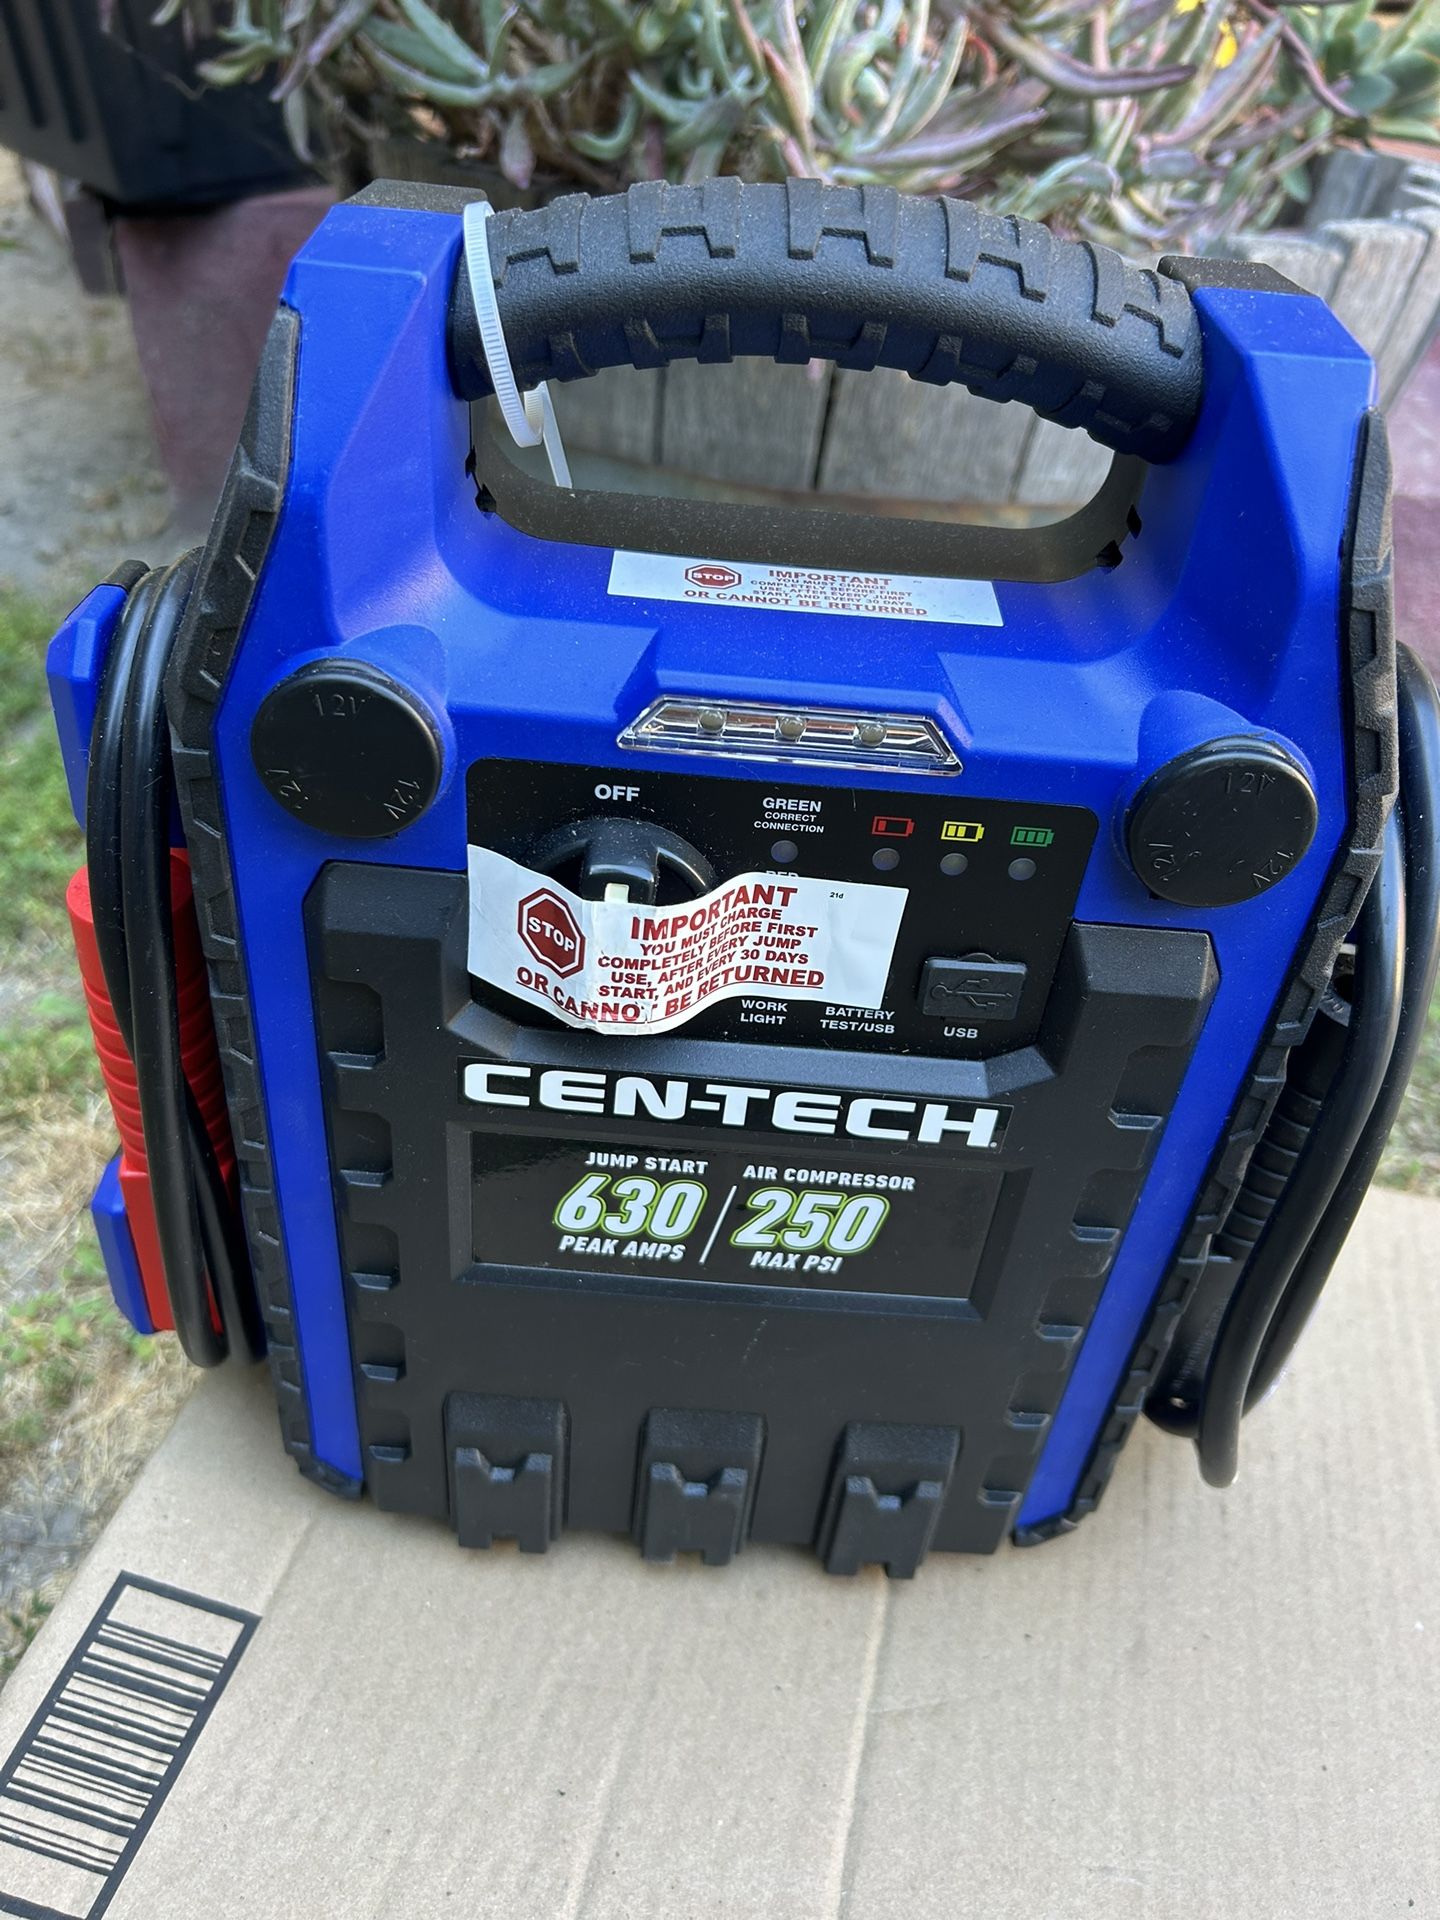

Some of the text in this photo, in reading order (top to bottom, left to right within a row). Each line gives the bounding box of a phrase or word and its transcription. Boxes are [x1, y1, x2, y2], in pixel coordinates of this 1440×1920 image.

[693, 572, 735, 581] STOP
[769, 570, 892, 586] IMPORTANT
[684, 590, 928, 615] OR CANNOT BE RETURNED
[594, 784, 640, 802] OFF
[762, 797, 822, 812] GREEN
[753, 820, 824, 833] CONNECTION
[764, 811, 817, 822] CORRECT
[630, 883, 798, 942] IMPORTANT
[528, 916, 575, 952] STOP
[640, 907, 783, 956] YOU MUST CHARGE
[598, 921, 818, 971] COMPLETELY BEFORE FIRST
[611, 935, 802, 987] USE, AFTER EVERY JUMP
[599, 949, 809, 1001] START, AND EVERY 30 DAYS
[516, 966, 549, 995] OR
[665, 991, 693, 1017] BE
[697, 965, 825, 1001] RETURNED
[741, 1000, 788, 1012] WORK
[825, 1006, 896, 1021] BATTERY
[740, 1013, 786, 1025] LIGHT
[820, 1019, 896, 1035] TEST/USB
[943, 1026, 979, 1039] USB
[464, 1063, 998, 1148] CEN-TECH
[585, 1151, 709, 1175] JUMP START
[742, 1164, 917, 1192] AIR COMPRESSOR
[553, 1173, 709, 1241] 630
[728, 1186, 891, 1255] 250
[559, 1236, 685, 1262] PEAK AMPS
[751, 1251, 844, 1274] MAX PSI
